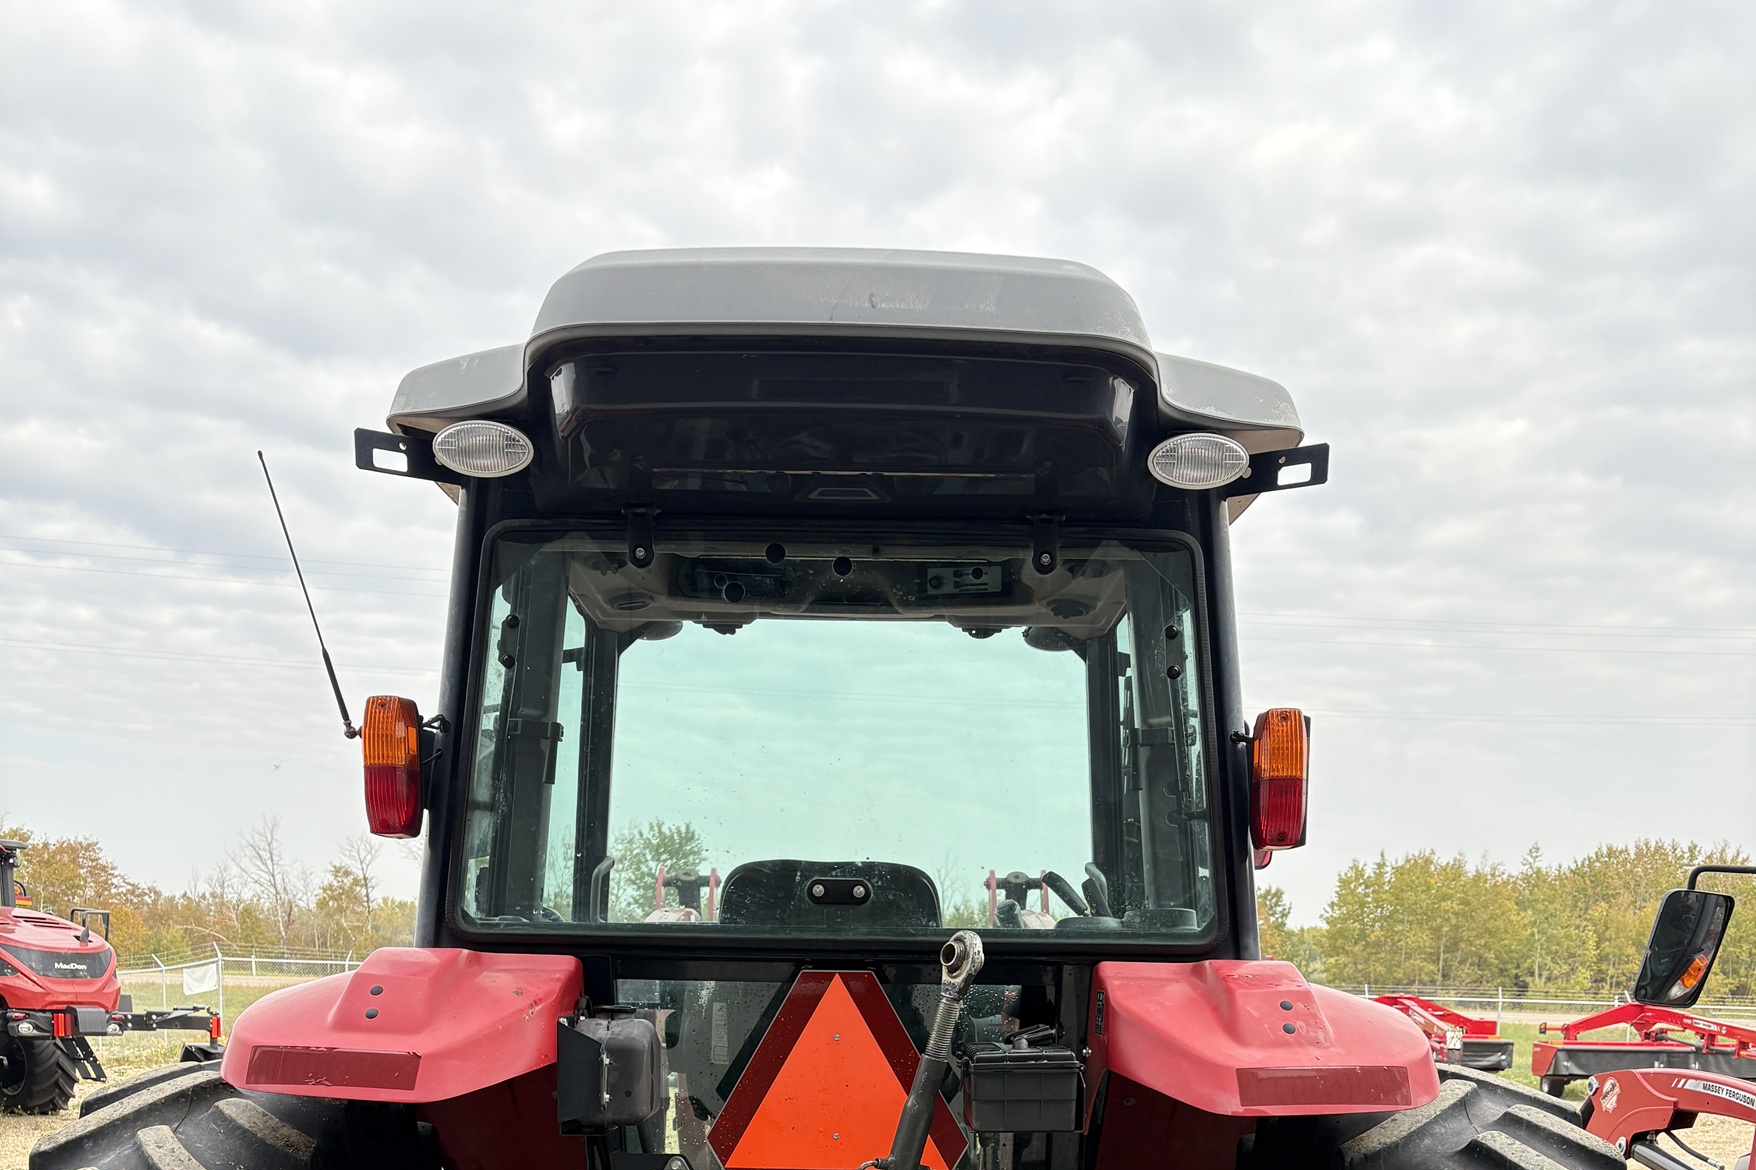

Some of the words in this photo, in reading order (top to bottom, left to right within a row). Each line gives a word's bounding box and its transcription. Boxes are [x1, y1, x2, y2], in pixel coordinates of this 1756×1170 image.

[54, 962, 87, 970] MacDon
[1702, 1082, 1725, 1095] MASSEY
[1725, 1088, 1756, 1107] FERGUSON
